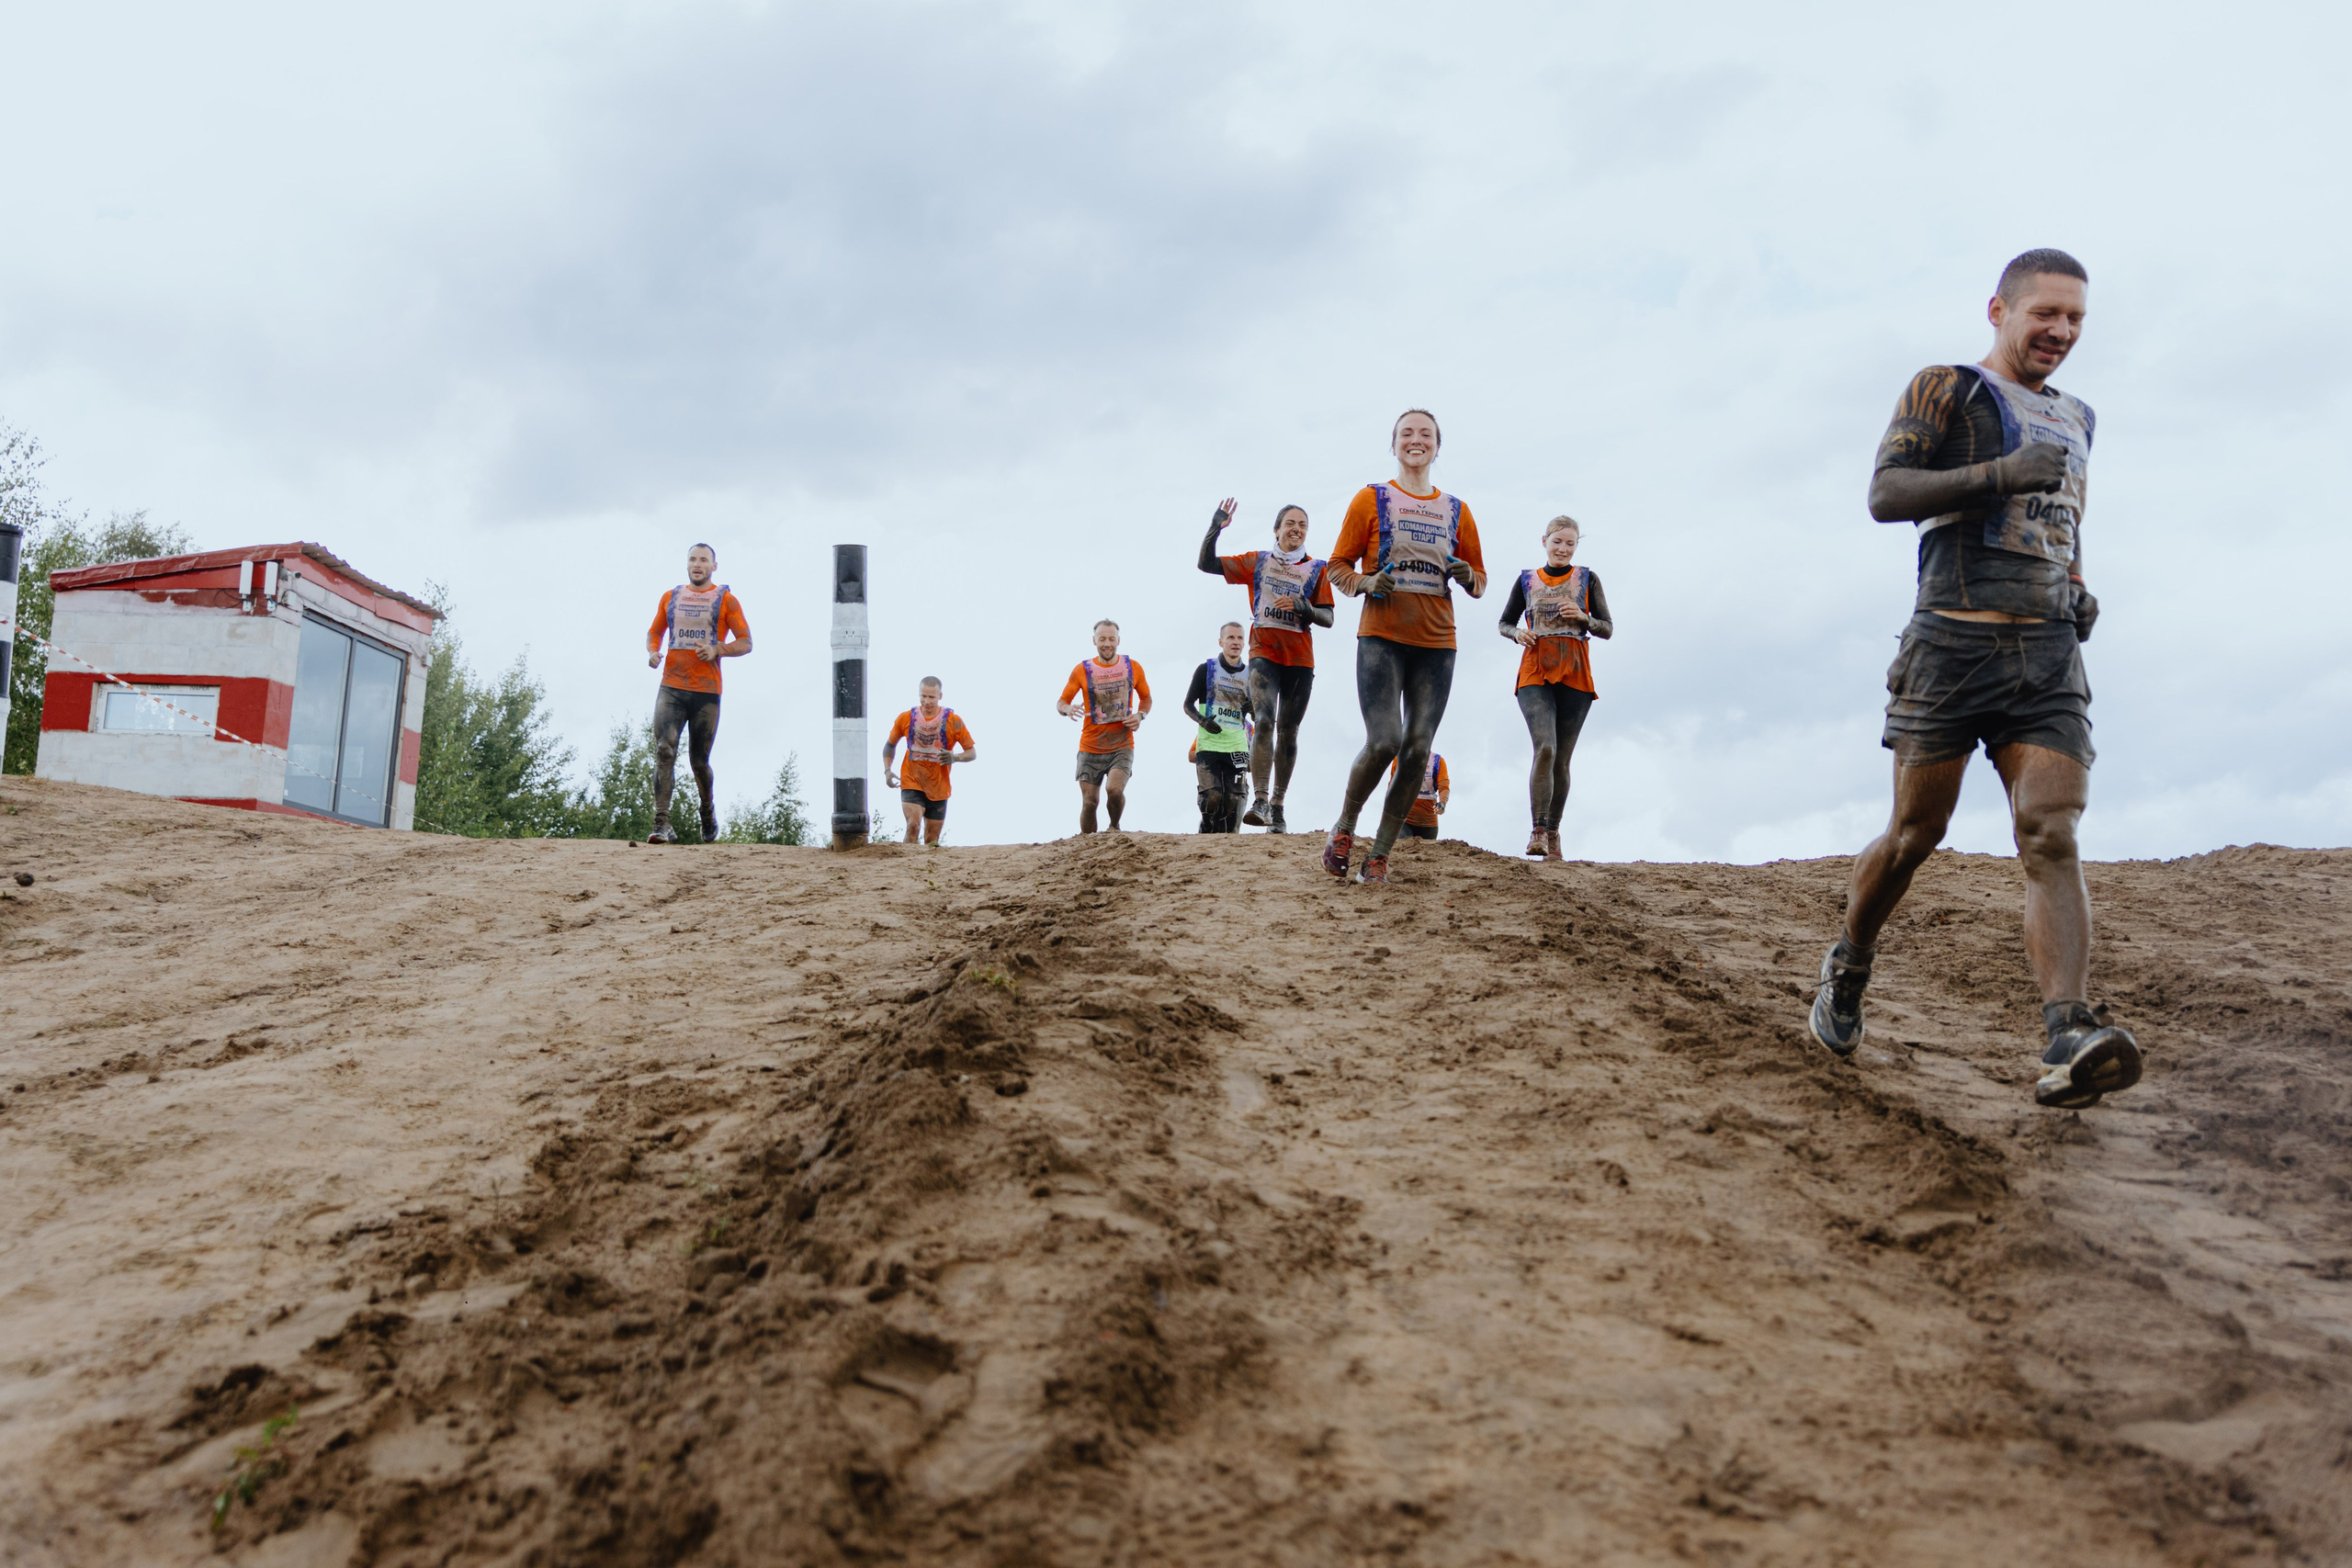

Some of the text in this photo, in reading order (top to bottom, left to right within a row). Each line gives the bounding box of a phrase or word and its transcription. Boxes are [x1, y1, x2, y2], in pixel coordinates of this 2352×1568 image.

[1421, 511, 1443, 519] ГЕРОЕВ
[1399, 521, 1446, 537] КОМАНДНЫЙ
[1412, 533, 1434, 543] СТАРТ
[679, 628, 706, 639] 04009
[1218, 707, 1241, 719] 04008
